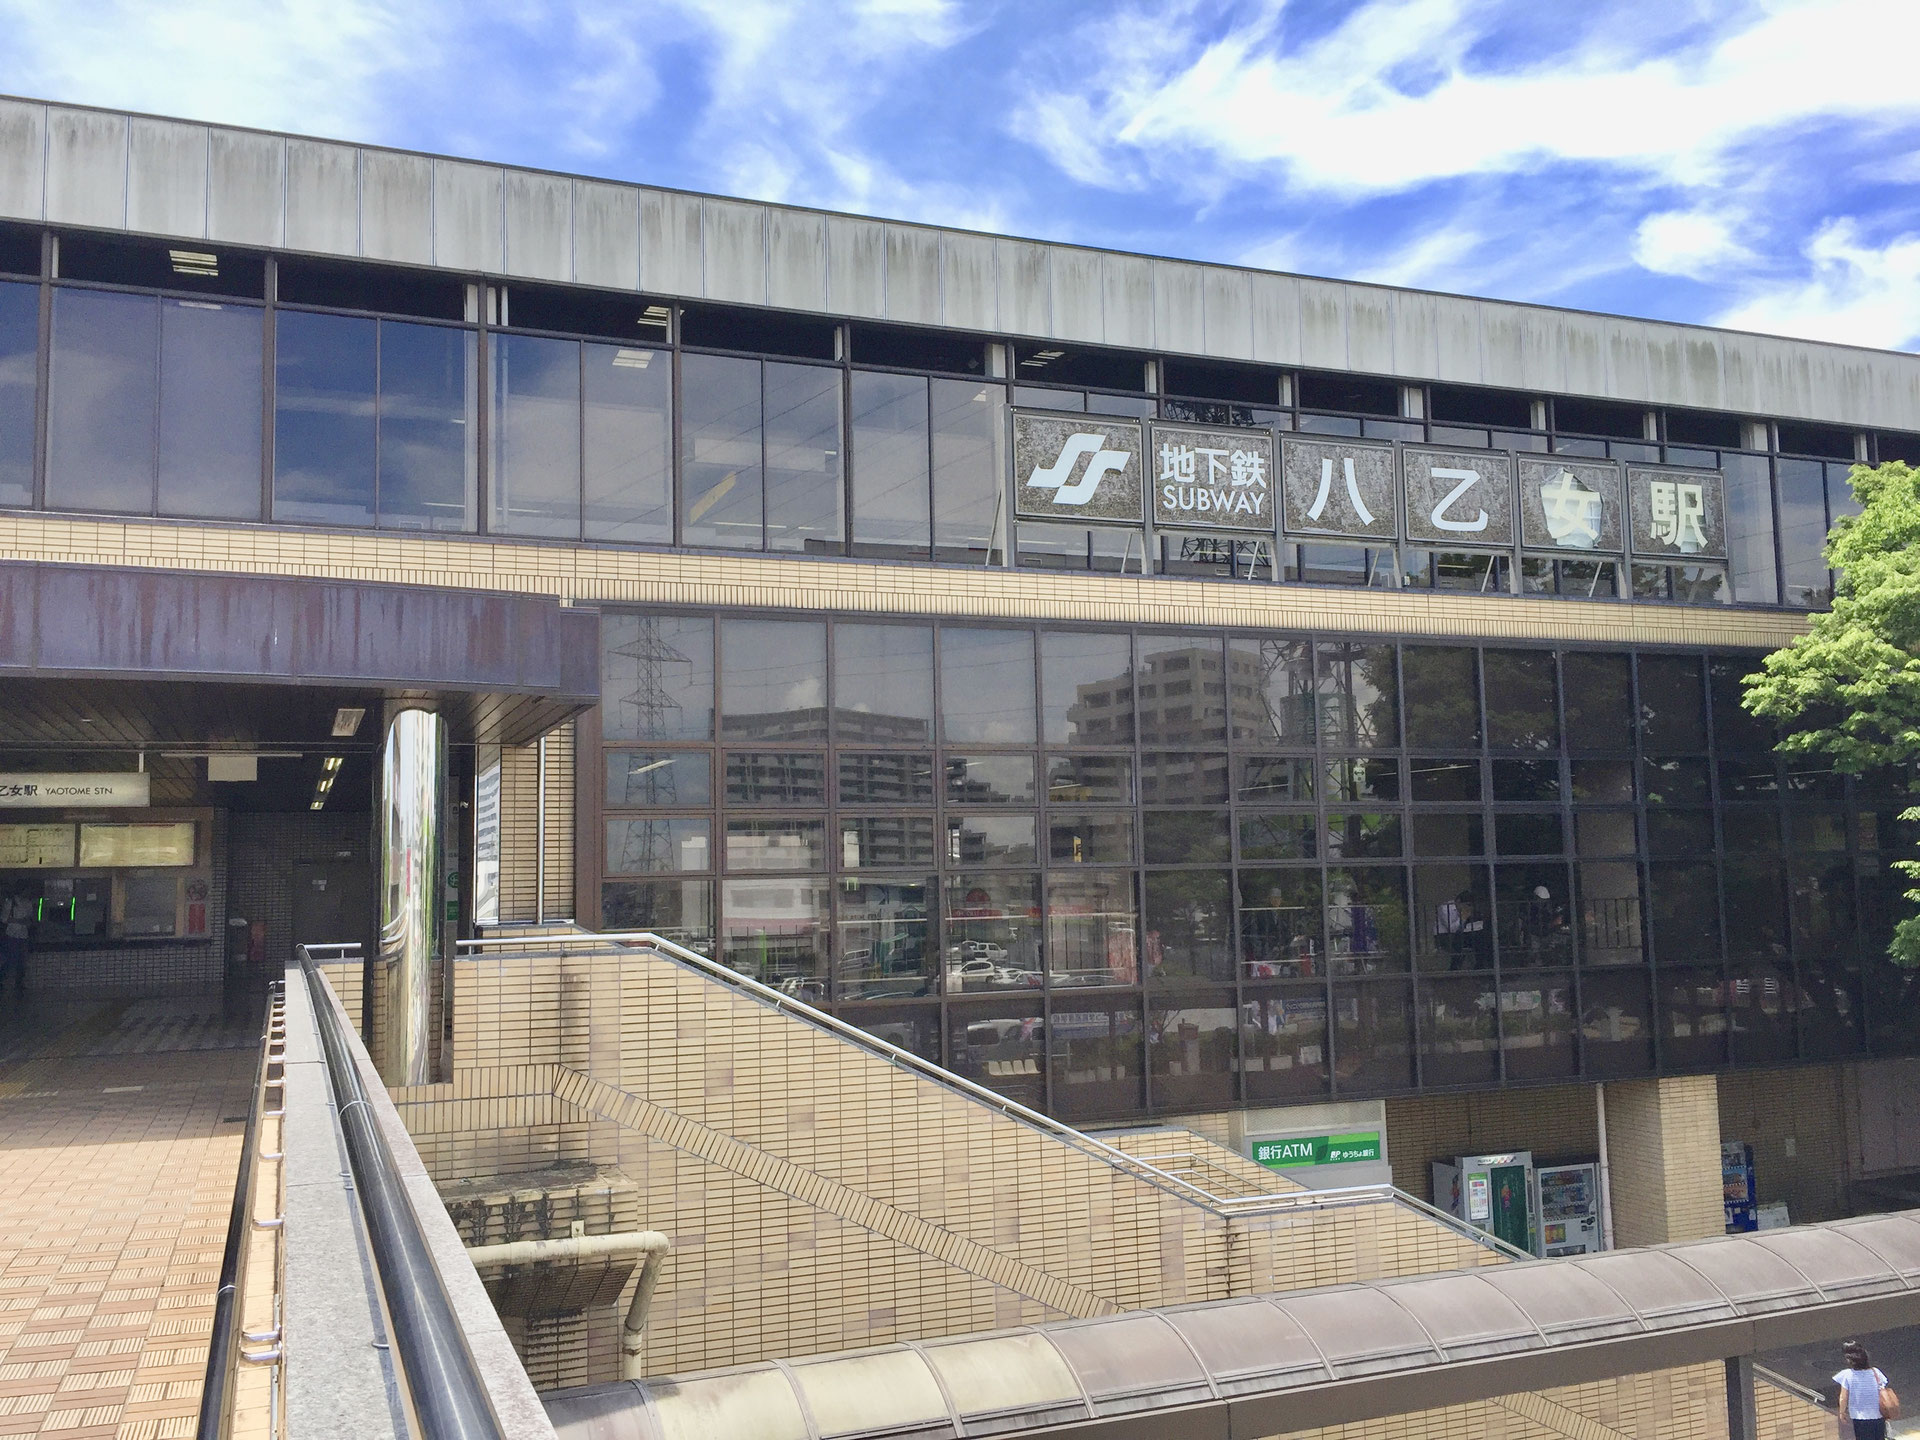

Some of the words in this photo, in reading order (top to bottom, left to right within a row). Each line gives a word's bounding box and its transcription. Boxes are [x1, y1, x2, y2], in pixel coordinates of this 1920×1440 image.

[1159, 443, 1267, 489] 地下鉄
[1162, 485, 1265, 515] SUBWAY
[45, 786, 91, 796] YAOTOME
[1257, 1142, 1313, 1161] 銀行ATM
